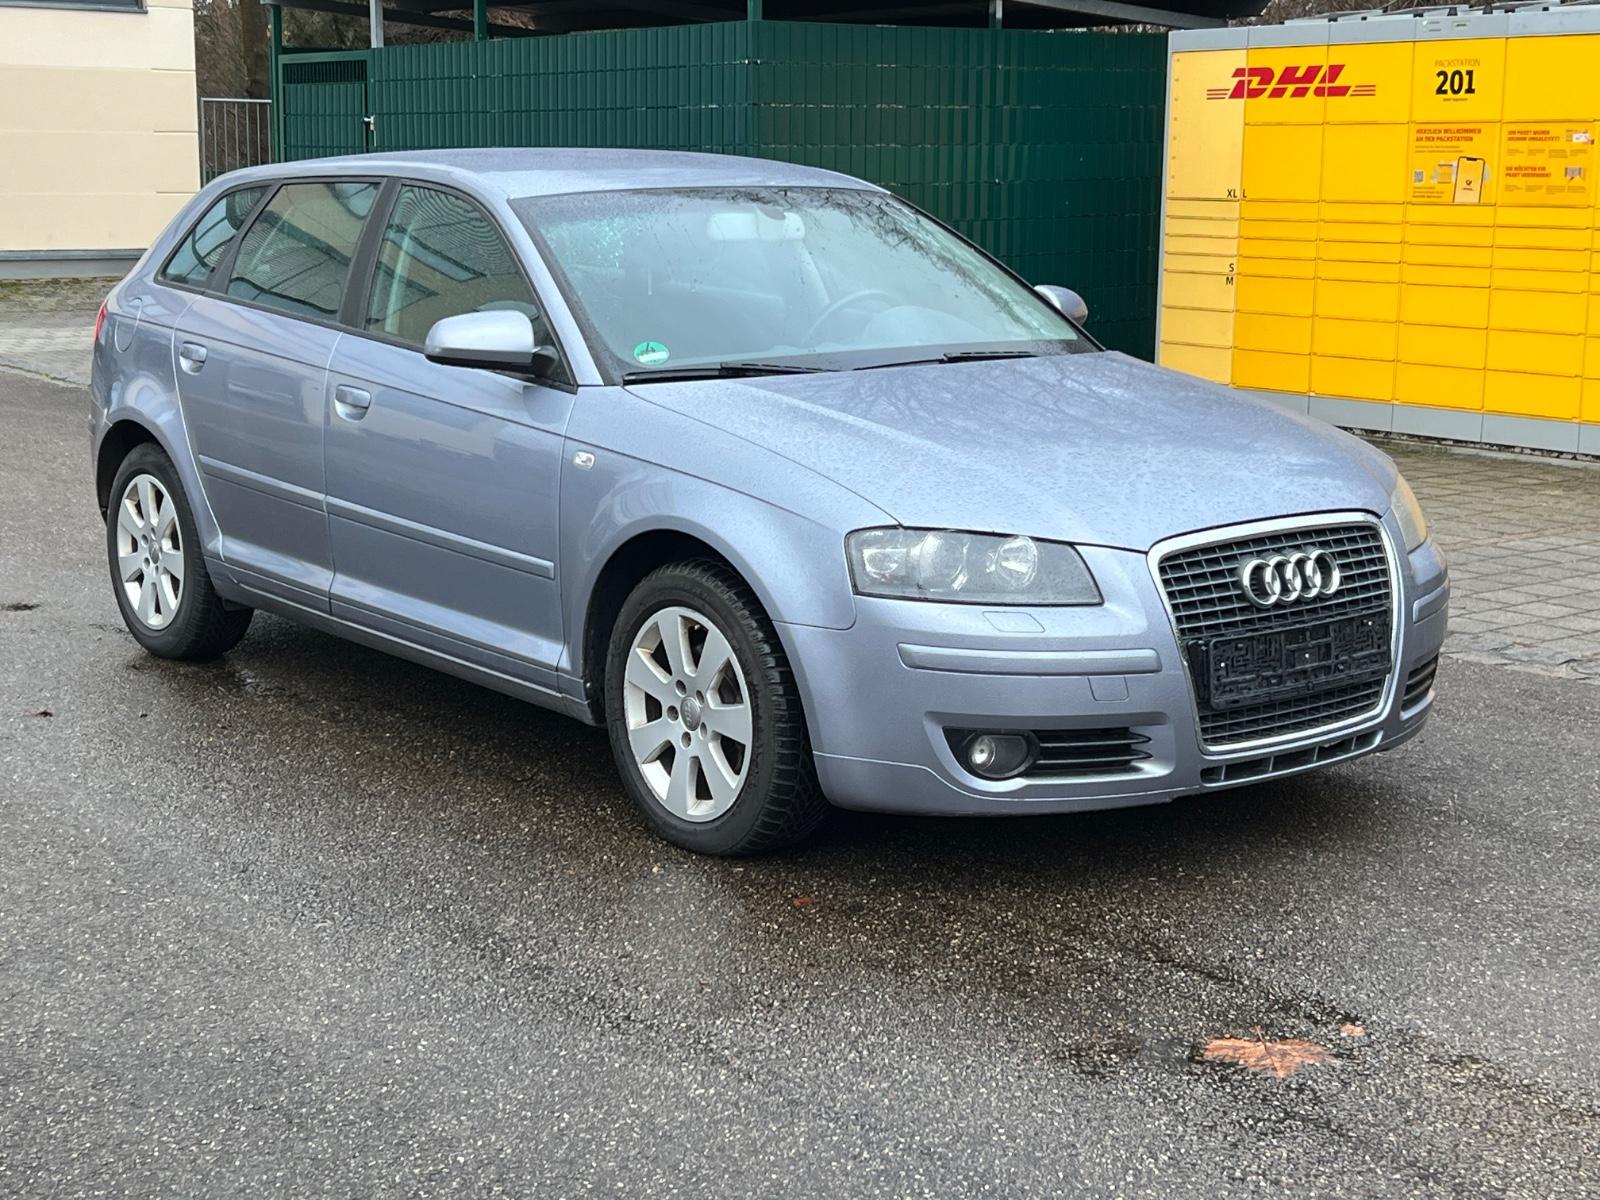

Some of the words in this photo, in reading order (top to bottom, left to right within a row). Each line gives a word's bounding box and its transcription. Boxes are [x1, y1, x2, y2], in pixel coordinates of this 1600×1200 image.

[1228, 64, 1352, 99] DHL
[1436, 70, 1475, 95] 201
[1227, 189, 1237, 198] XL
[1242, 189, 1247, 198] L
[1229, 263, 1234, 272] S
[1226, 277, 1234, 285] M
